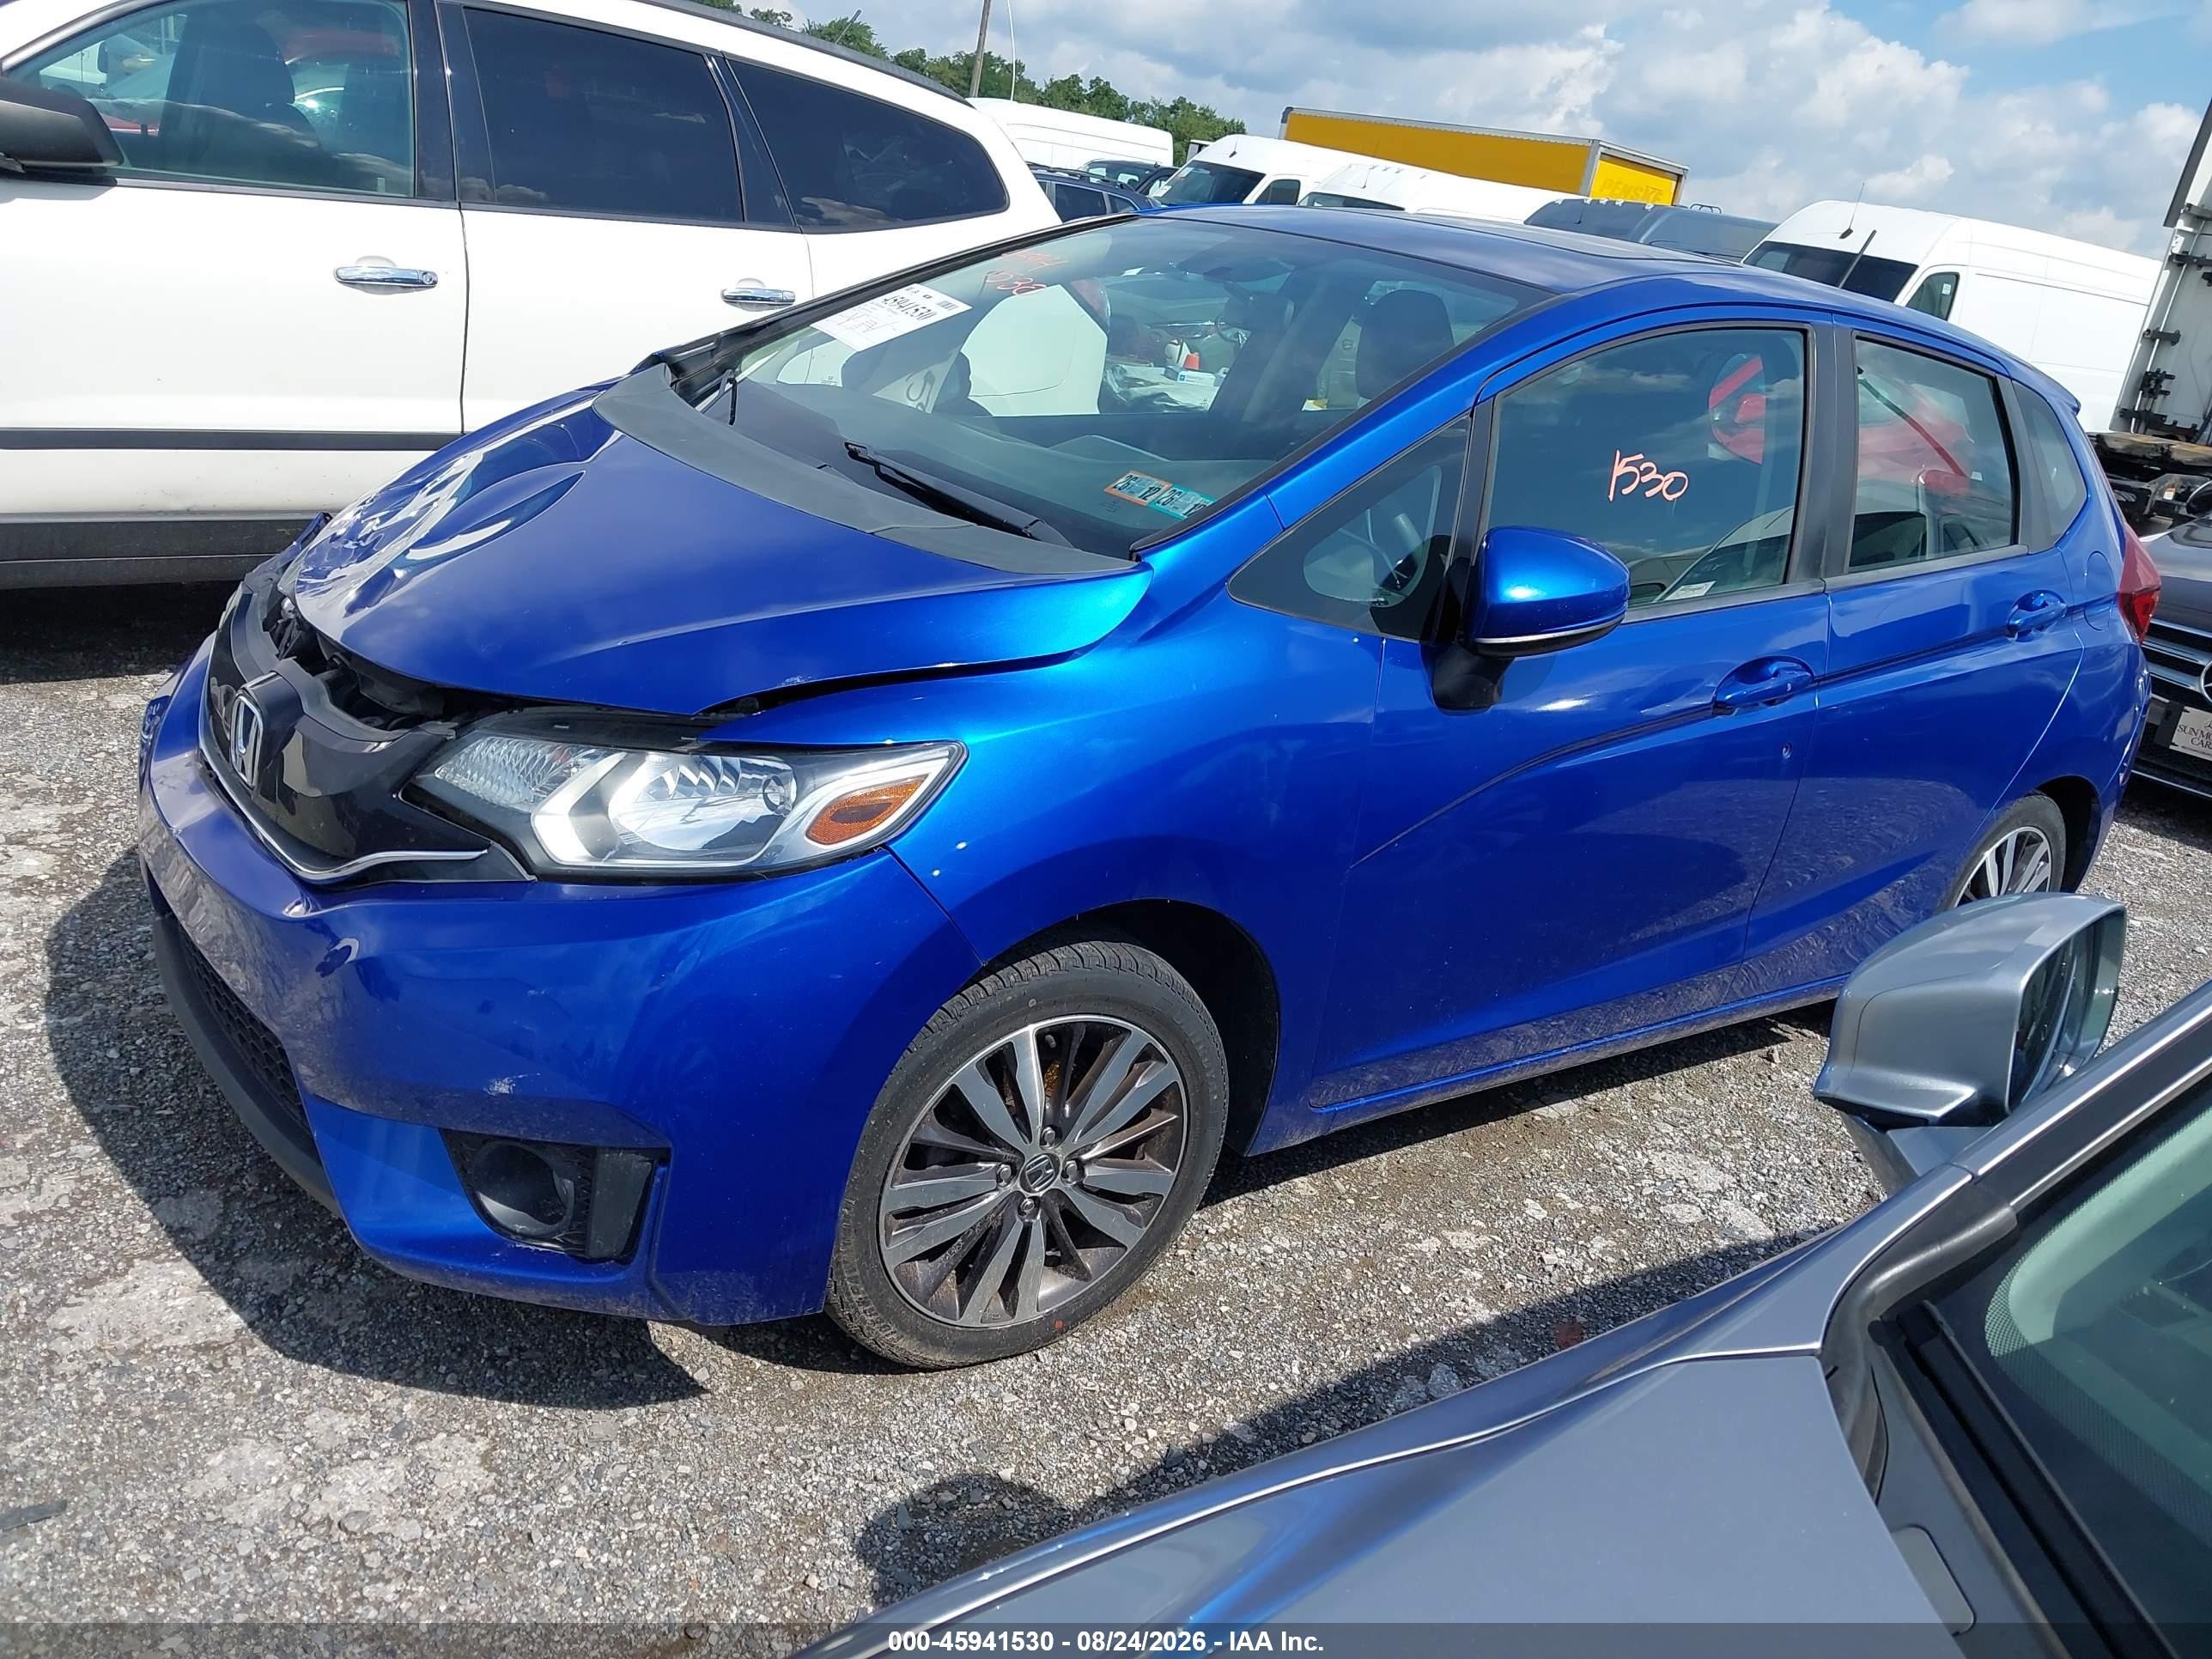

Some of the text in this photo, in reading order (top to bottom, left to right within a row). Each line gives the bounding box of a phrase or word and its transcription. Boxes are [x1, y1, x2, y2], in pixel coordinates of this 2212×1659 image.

[1607, 449, 1689, 502] 1530
[1112, 474, 1162, 501] 26 12
[1156, 489, 1183, 507] 26
[2177, 724, 2199, 737] SUN
